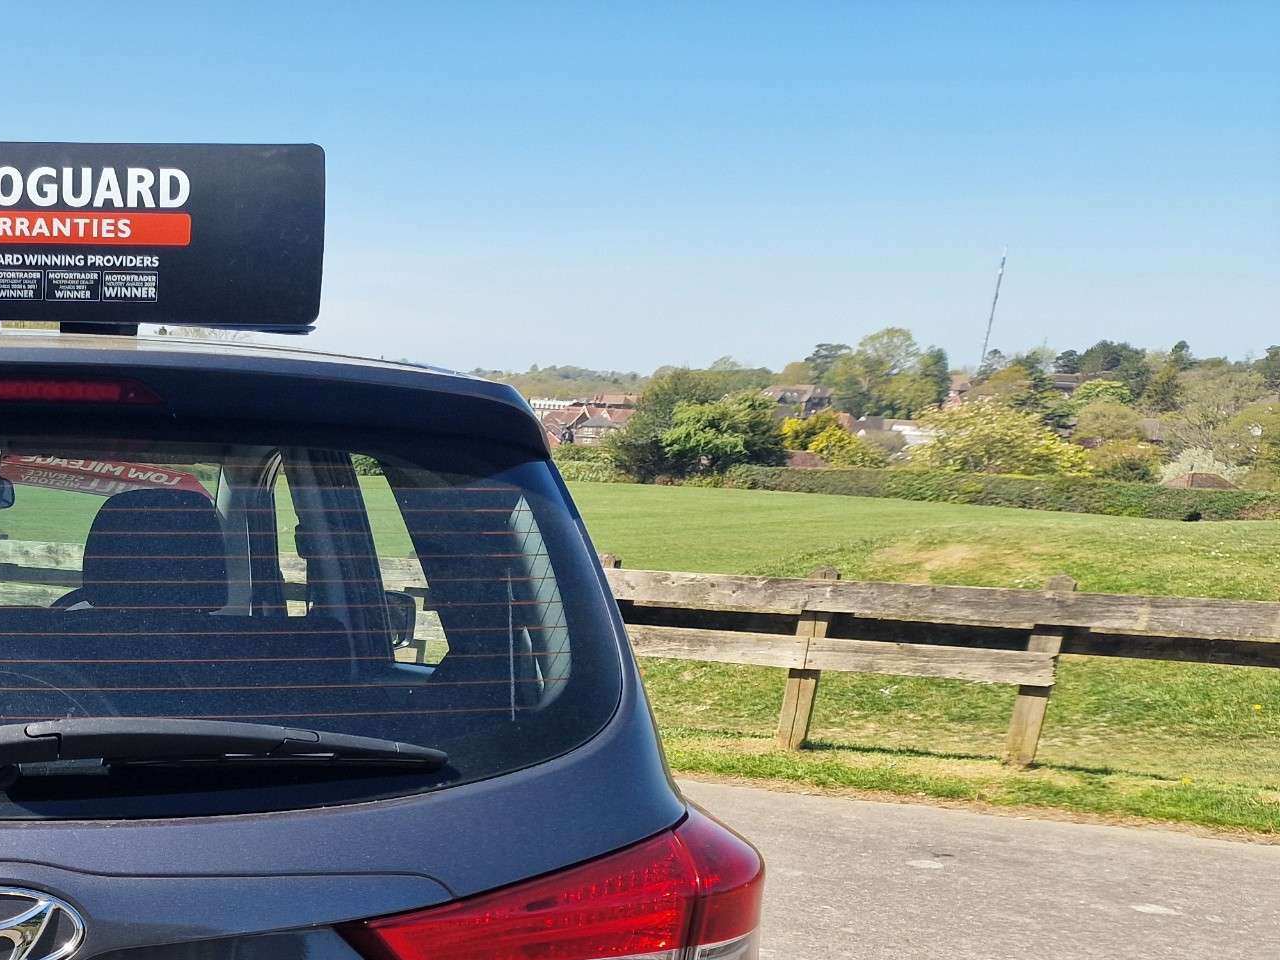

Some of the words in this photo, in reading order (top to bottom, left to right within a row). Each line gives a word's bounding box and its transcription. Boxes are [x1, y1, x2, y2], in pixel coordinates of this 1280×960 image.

[24, 254, 85, 267] WINNING
[87, 255, 160, 268] PROVIDERS
[48, 272, 99, 280] MOTORTRADER
[54, 290, 91, 299] WINNER
[104, 286, 156, 298] WINNER
